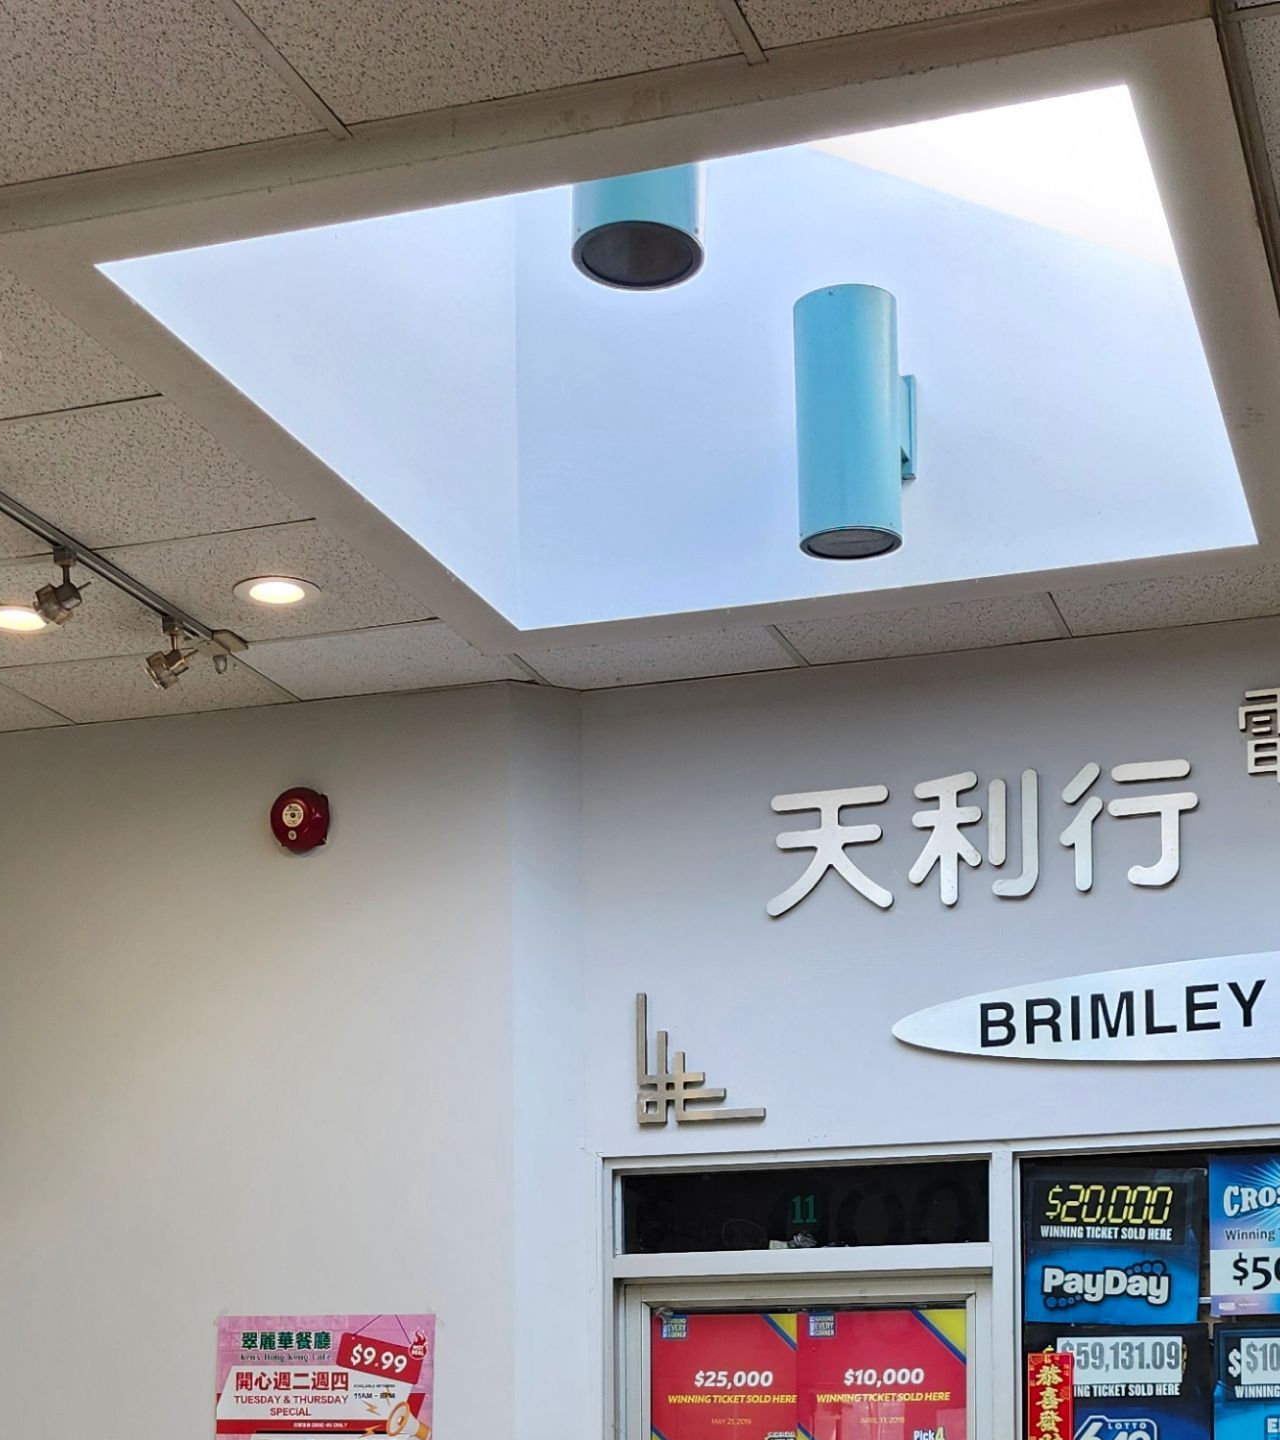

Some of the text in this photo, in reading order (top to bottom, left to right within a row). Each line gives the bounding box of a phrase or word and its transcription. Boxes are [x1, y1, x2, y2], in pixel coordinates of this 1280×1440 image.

[766, 758, 1199, 917] 天利行
[979, 978, 1267, 1049] BRIMLEY
[1045, 1184, 1174, 1225] $20,000
[1225, 1228, 1276, 1242] Winning
[1043, 1266, 1169, 1306] PayDay
[240, 1331, 332, 1351] 翠麗華餐廳
[350, 1343, 408, 1374] $9.99
[235, 1371, 349, 1392] 開心週二週四
[843, 1367, 925, 1388] $10,000
[234, 1395, 349, 1404] TUESDAY & THURSDAY
[1235, 1385, 1280, 1399] WINNING
[270, 1407, 312, 1417] SPECIAL
